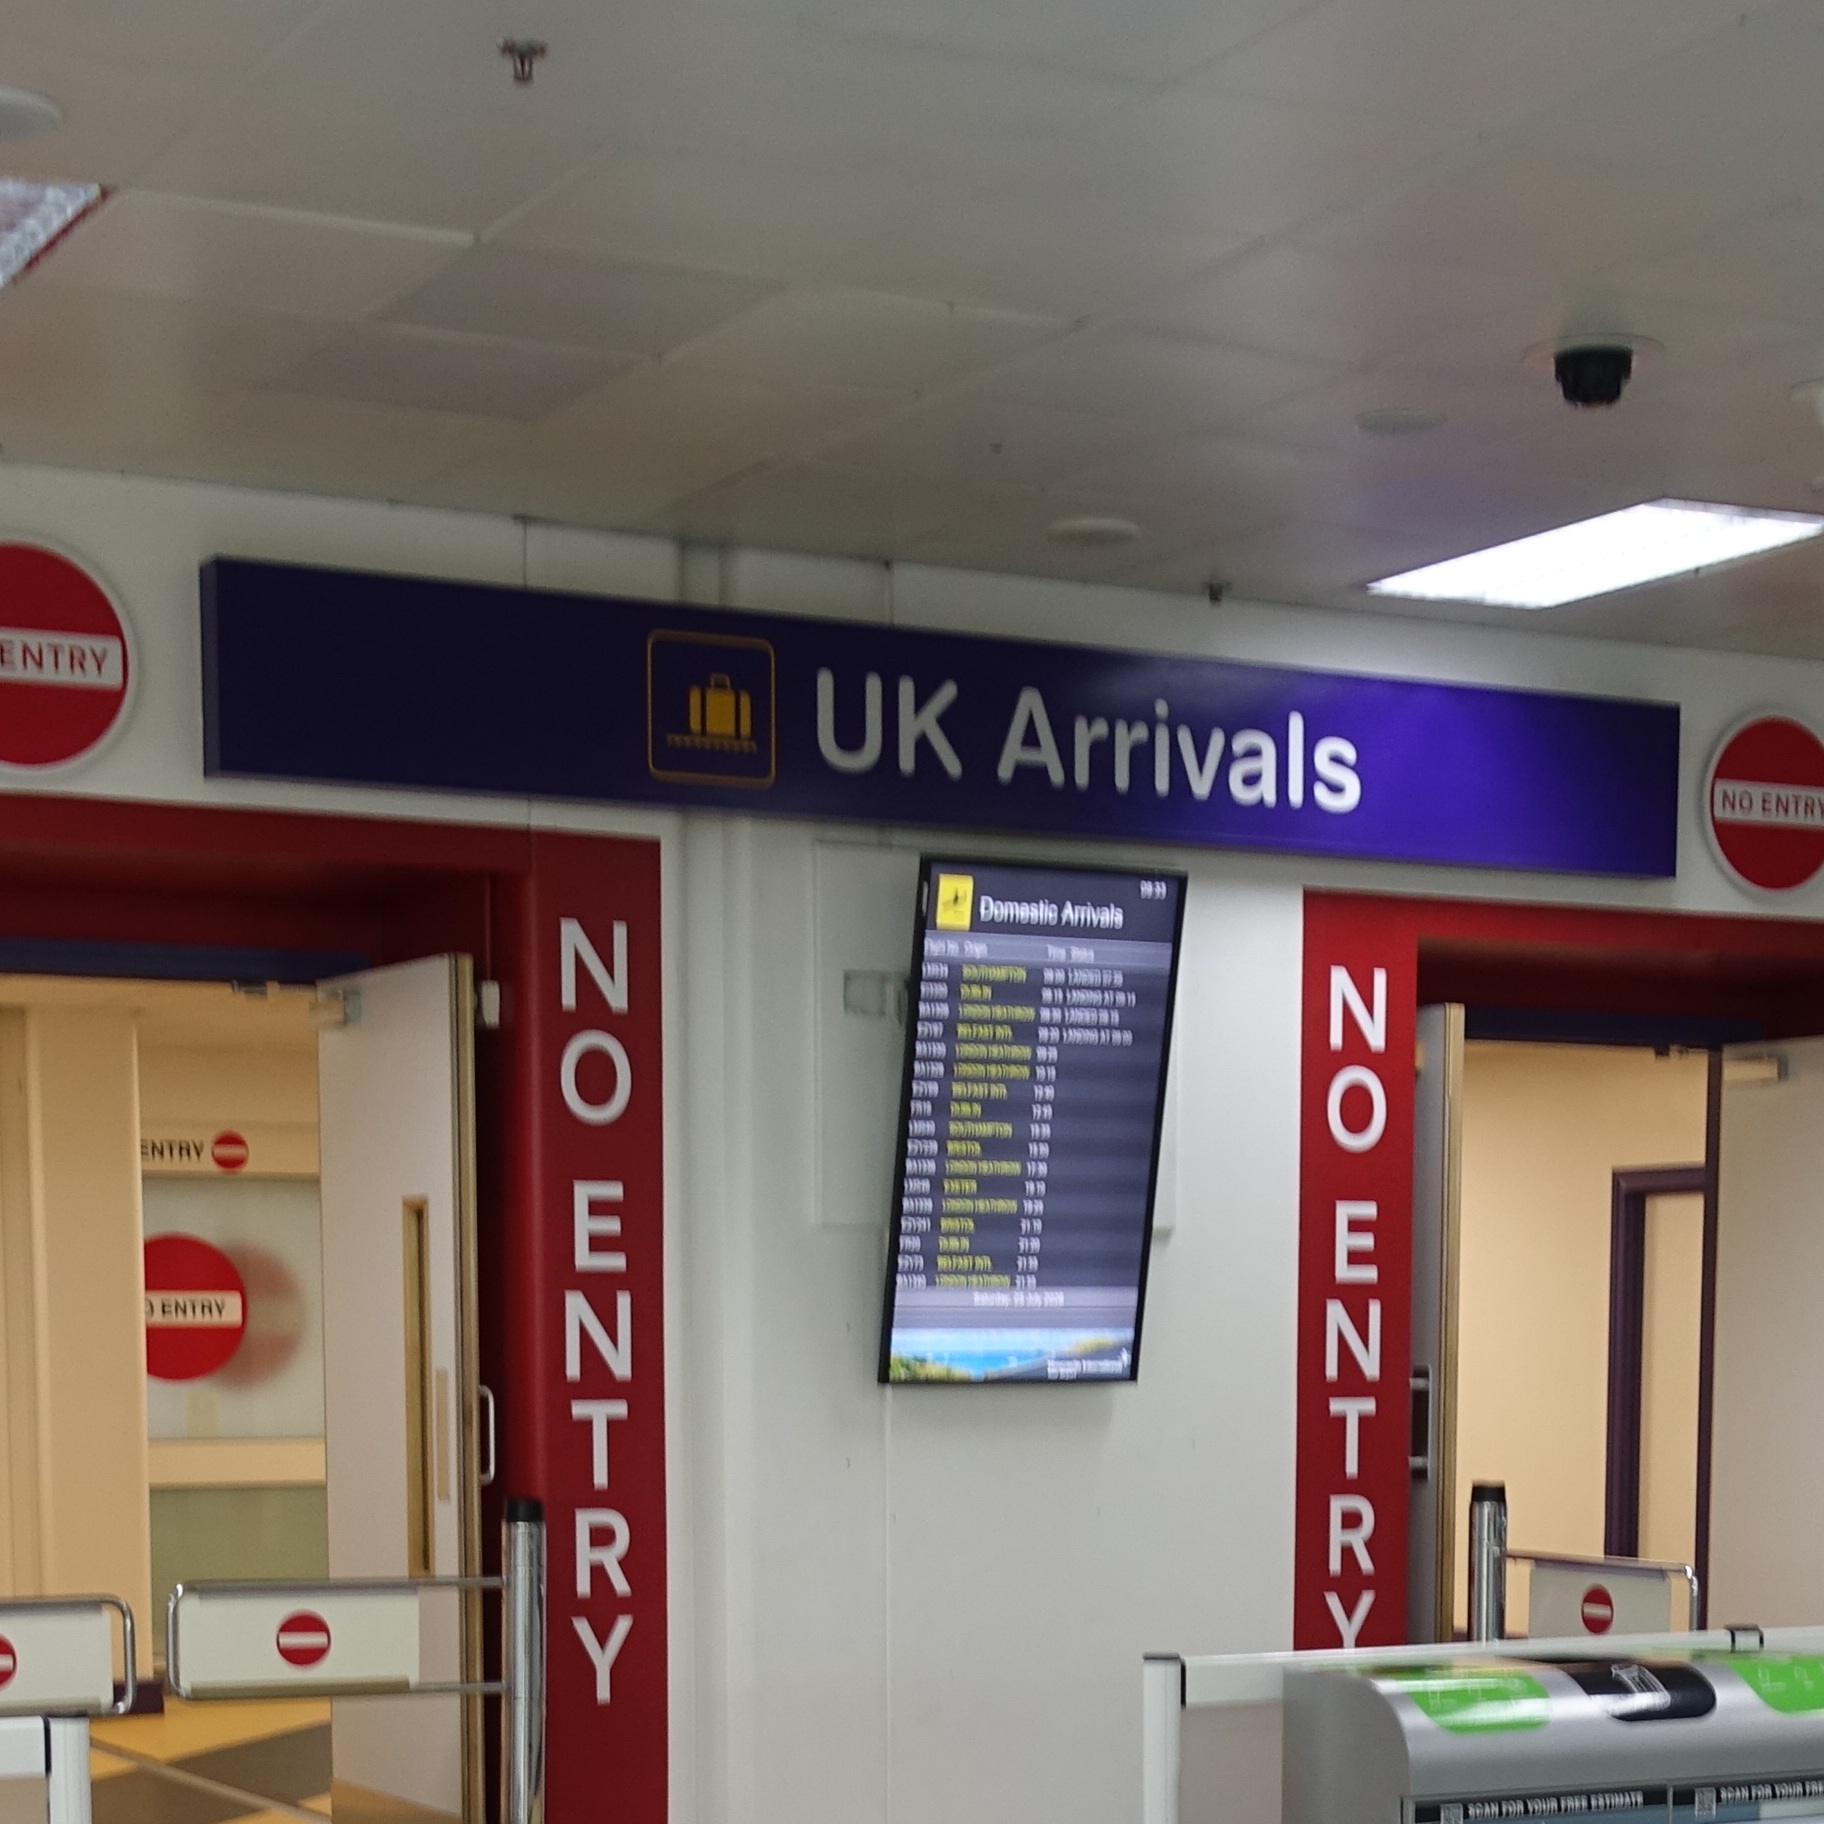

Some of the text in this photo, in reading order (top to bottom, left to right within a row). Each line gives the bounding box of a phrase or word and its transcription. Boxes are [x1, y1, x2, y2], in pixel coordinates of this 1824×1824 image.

[816, 666, 1362, 814] UK Arrivals
[1722, 789, 1753, 815] NO
[979, 895, 1124, 930] Domestic Arrivals
[162, 1298, 225, 1320] ENTRY
[561, 918, 633, 1704] NO ENTRY
[1323, 964, 1388, 1648] NO ENTRY
[1502, 1800, 1525, 1818] FOR
[1526, 1797, 1558, 1815] YOUR
